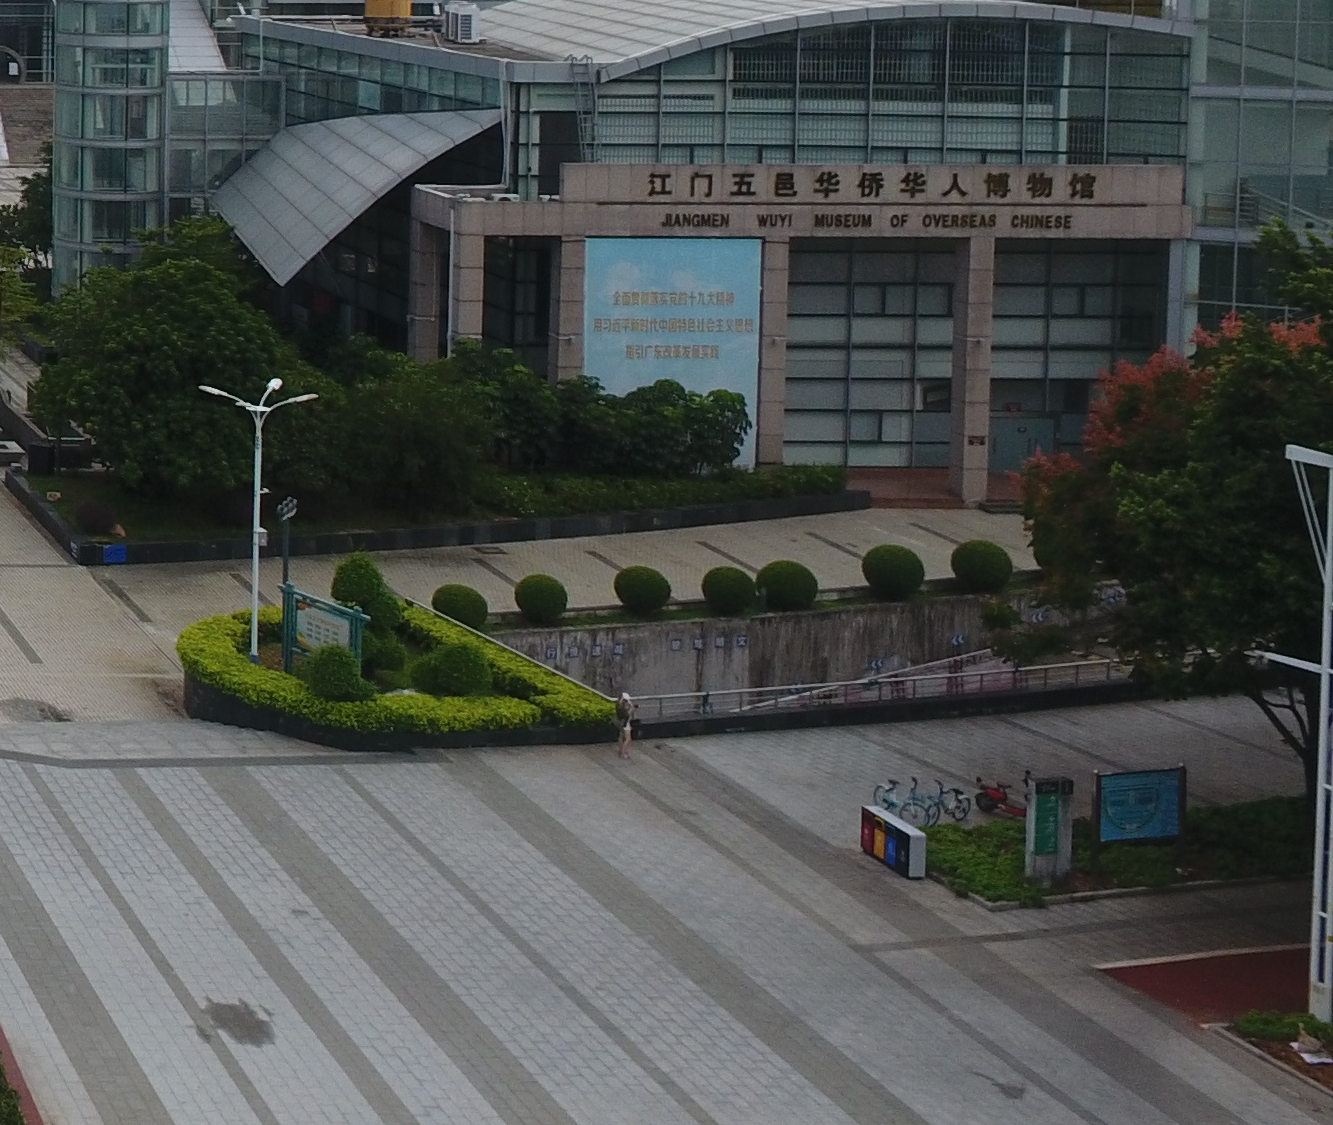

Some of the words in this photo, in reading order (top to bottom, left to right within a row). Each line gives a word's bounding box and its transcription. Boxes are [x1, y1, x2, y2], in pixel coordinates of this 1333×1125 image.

[647, 171, 1097, 199] 江门五邑华侨华人博物馆
[661, 213, 730, 228] JIANGMEN
[757, 213, 792, 228] WUYI
[814, 213, 872, 228] MUSEUM
[890, 214, 908, 228] OF
[922, 213, 997, 229] OVERSEAS
[1011, 213, 1072, 229] CHINESE
